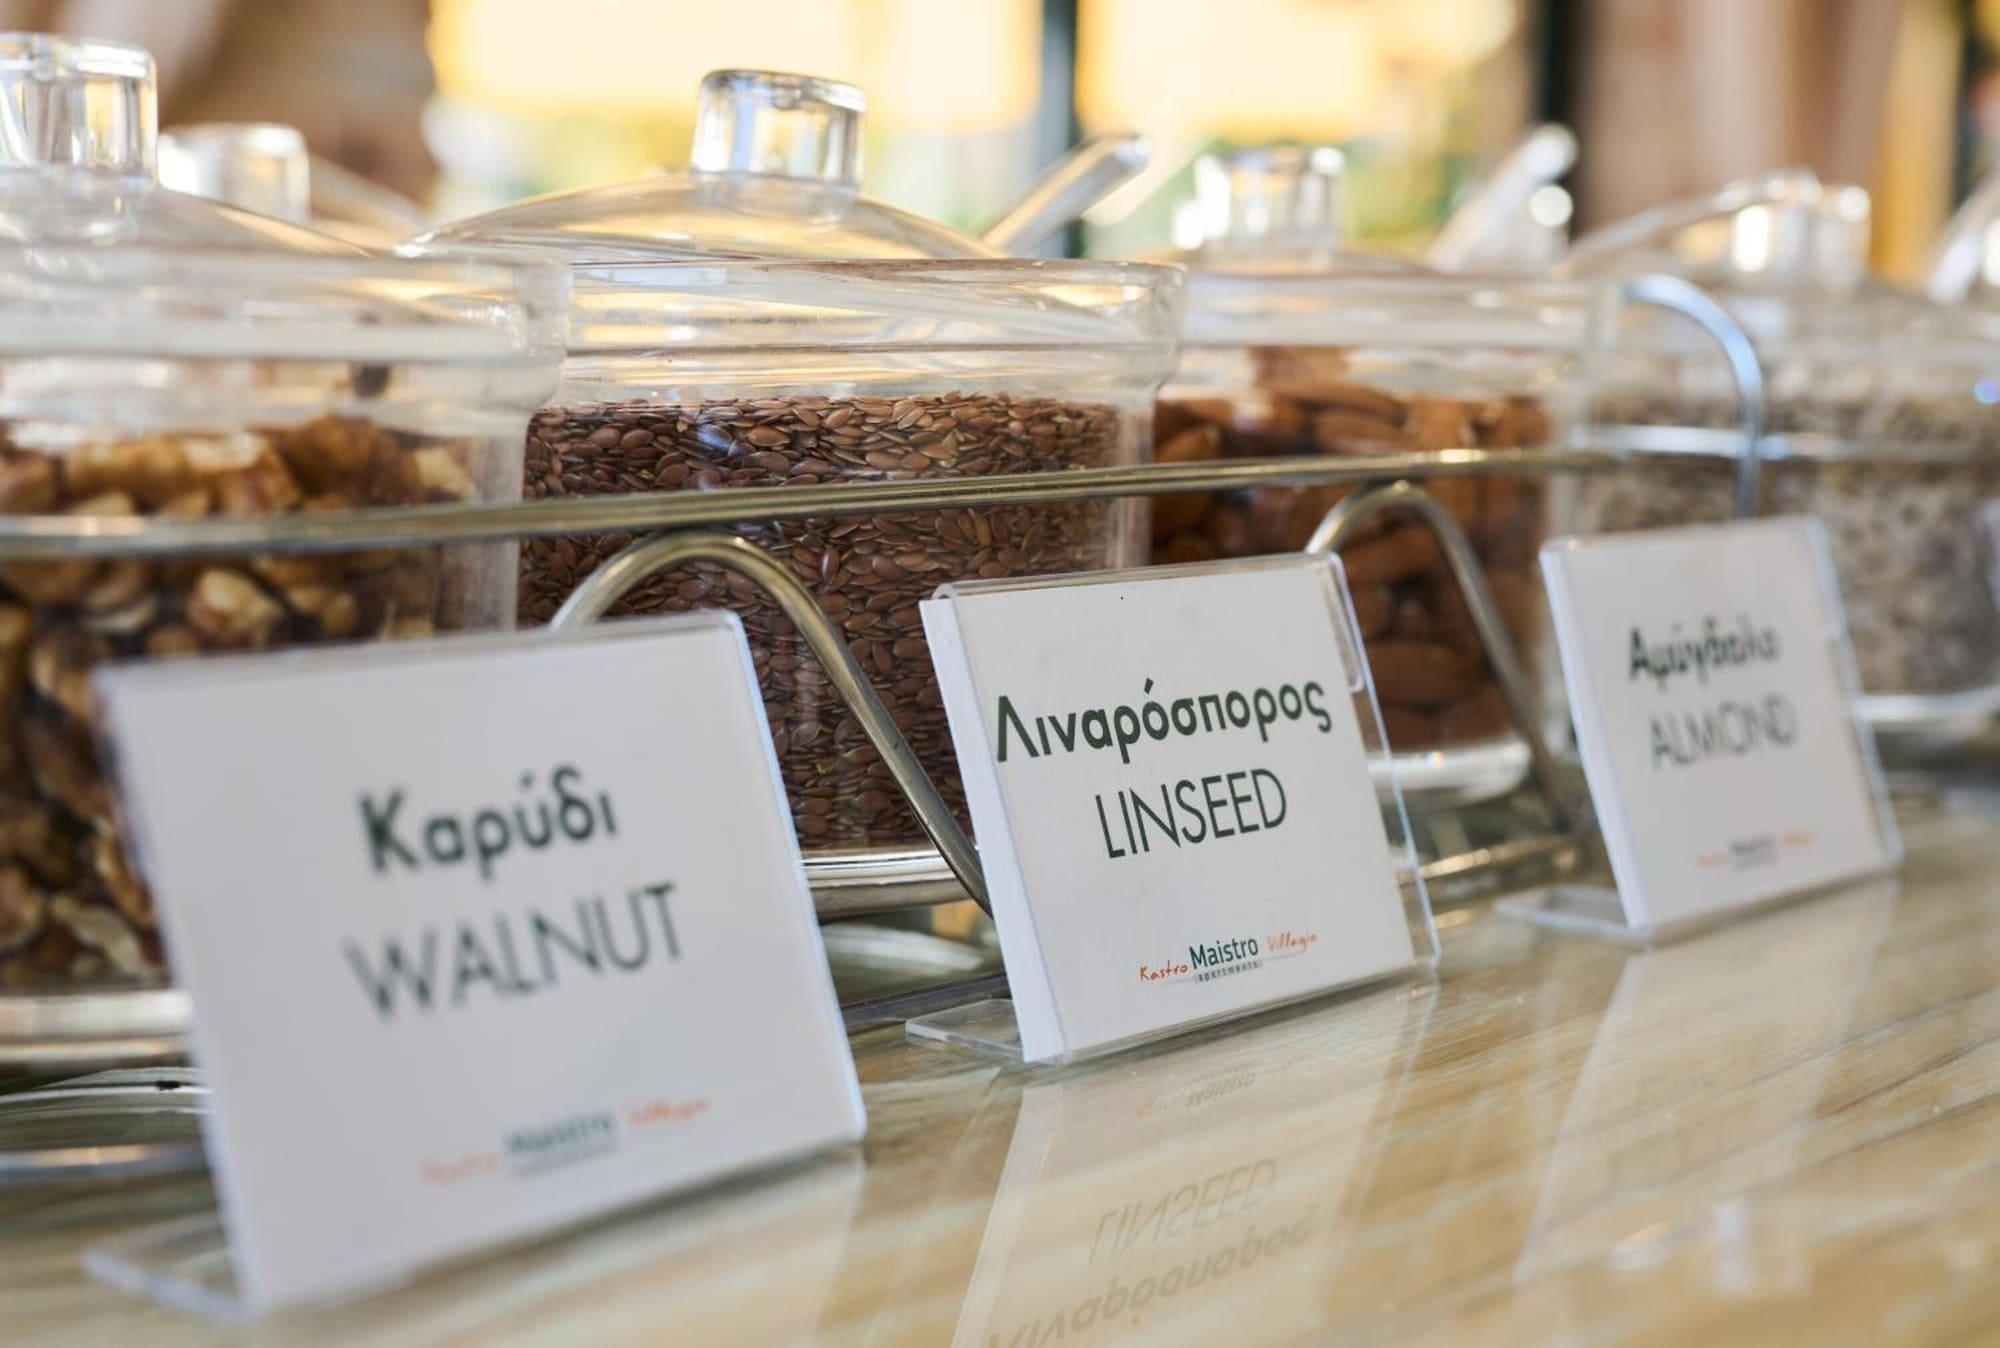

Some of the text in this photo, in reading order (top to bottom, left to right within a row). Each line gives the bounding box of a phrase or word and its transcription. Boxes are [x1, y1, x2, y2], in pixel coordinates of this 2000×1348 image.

[997, 677, 1332, 764] Λιναρόσπορος
[1650, 694, 1797, 770] ALMOND
[358, 763, 617, 880] Καρύδι
[1095, 768, 1287, 859] LINSEED
[341, 880, 682, 1020] WALNUT
[1139, 959, 1189, 982] Kastro
[1189, 937, 1259, 970] Maistro
